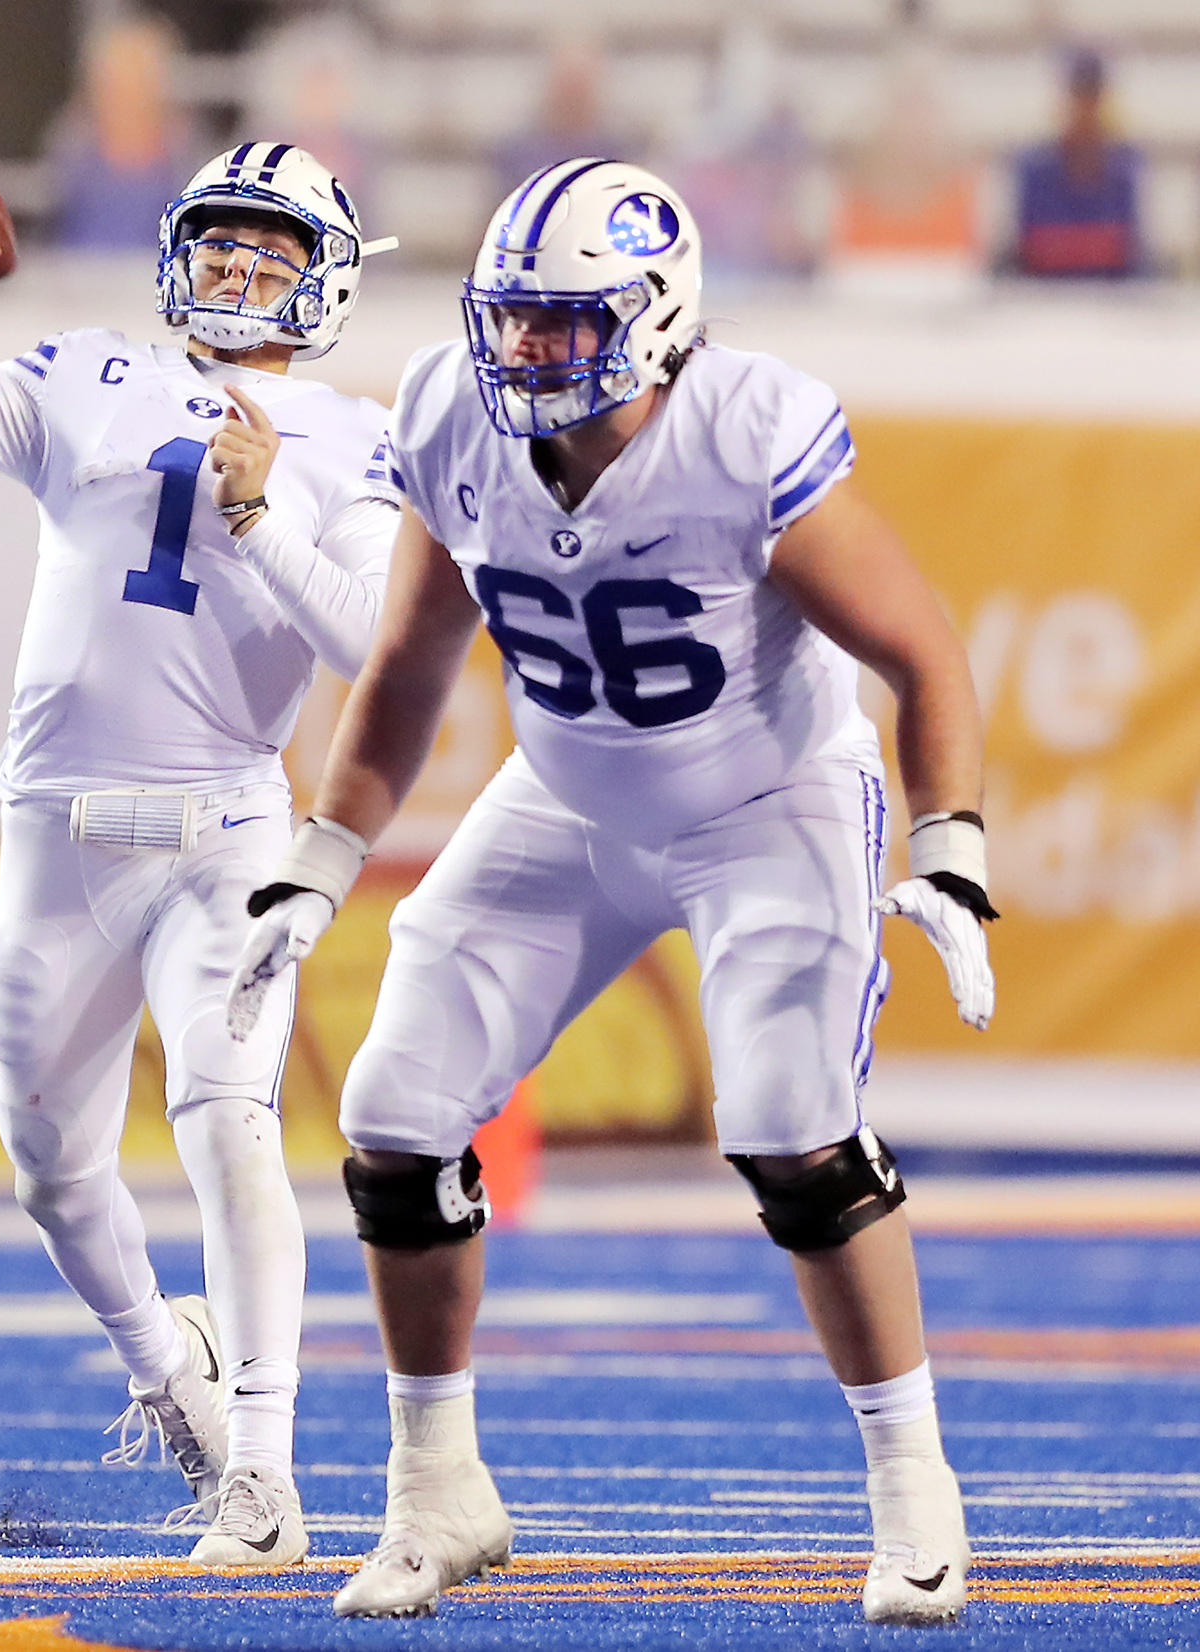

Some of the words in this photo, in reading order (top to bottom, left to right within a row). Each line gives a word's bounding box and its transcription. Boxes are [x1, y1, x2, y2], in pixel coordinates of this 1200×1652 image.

[612, 194, 672, 251] Y
[100, 357, 130, 385] C
[122, 436, 208, 616] 1
[458, 483, 478, 522] C
[475, 564, 726, 728] 66
